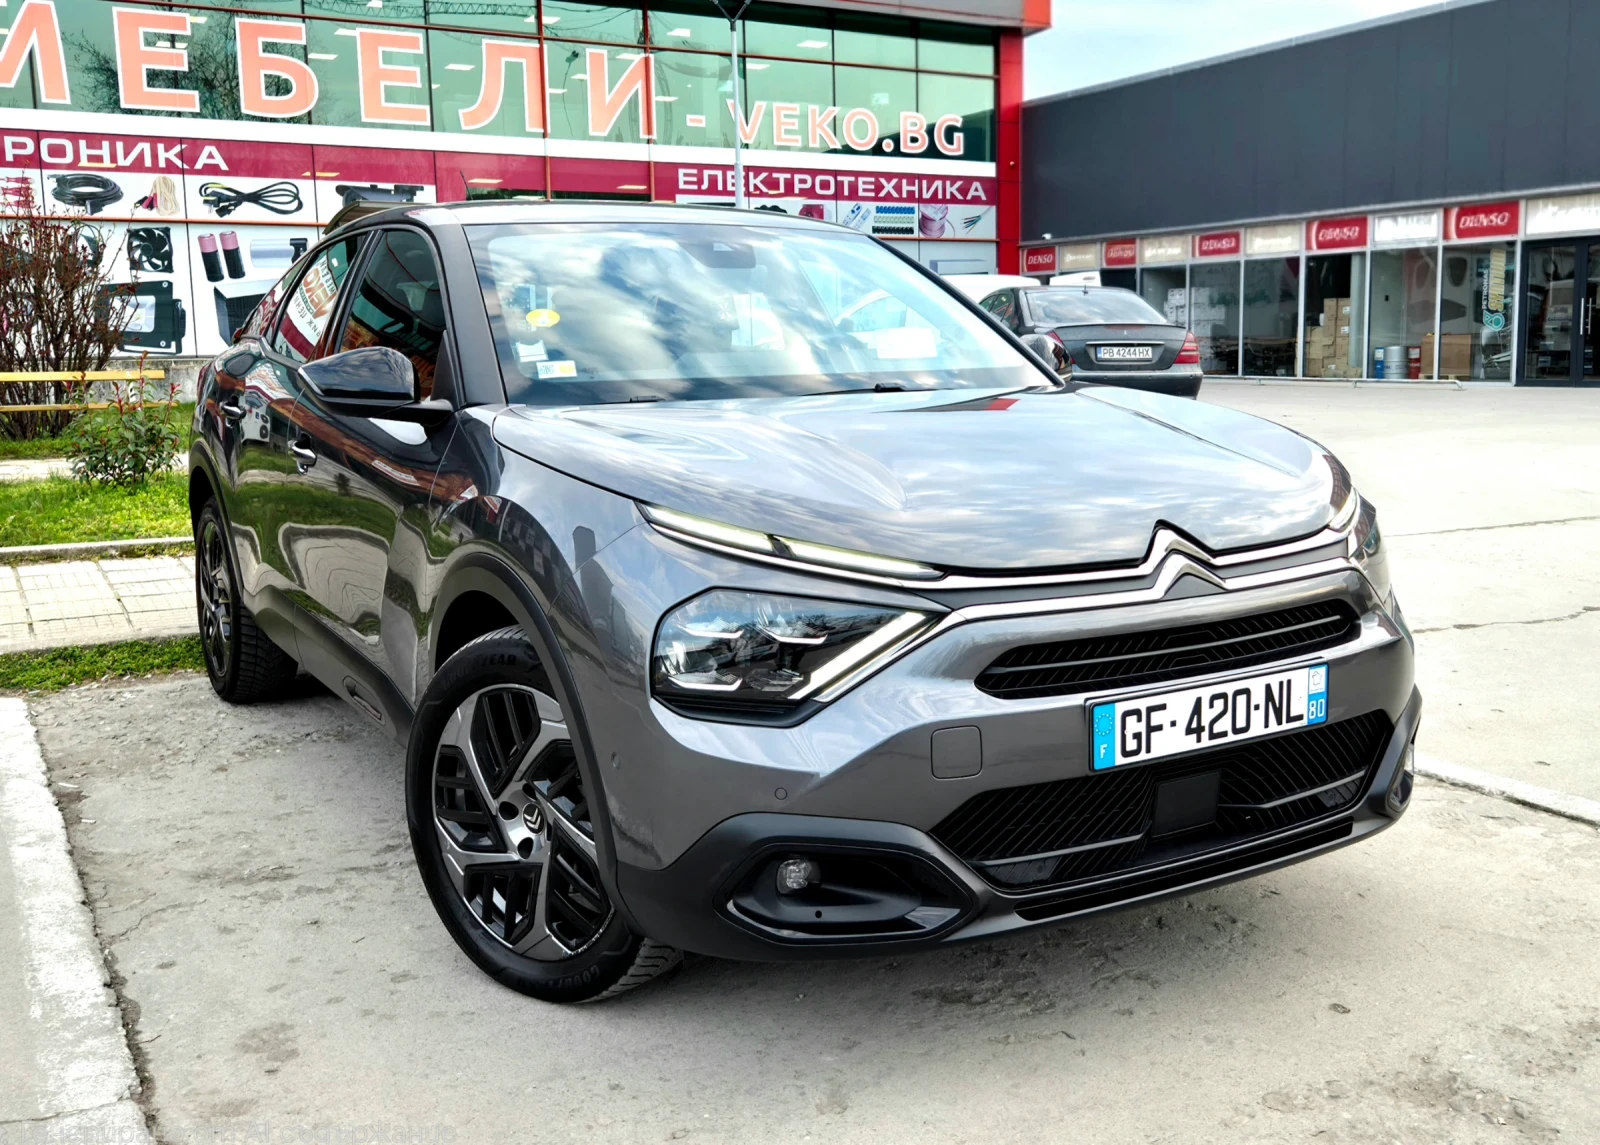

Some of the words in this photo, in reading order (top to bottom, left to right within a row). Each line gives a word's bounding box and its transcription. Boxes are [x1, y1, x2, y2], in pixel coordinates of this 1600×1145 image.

[725, 98, 964, 155] VEKO.BG
[1458, 211, 1510, 229] DENSO
[1318, 226, 1360, 240] DENSO
[1027, 253, 1053, 265] DENSO
[1099, 744, 1108, 759] F
[1308, 698, 1325, 720] 80
